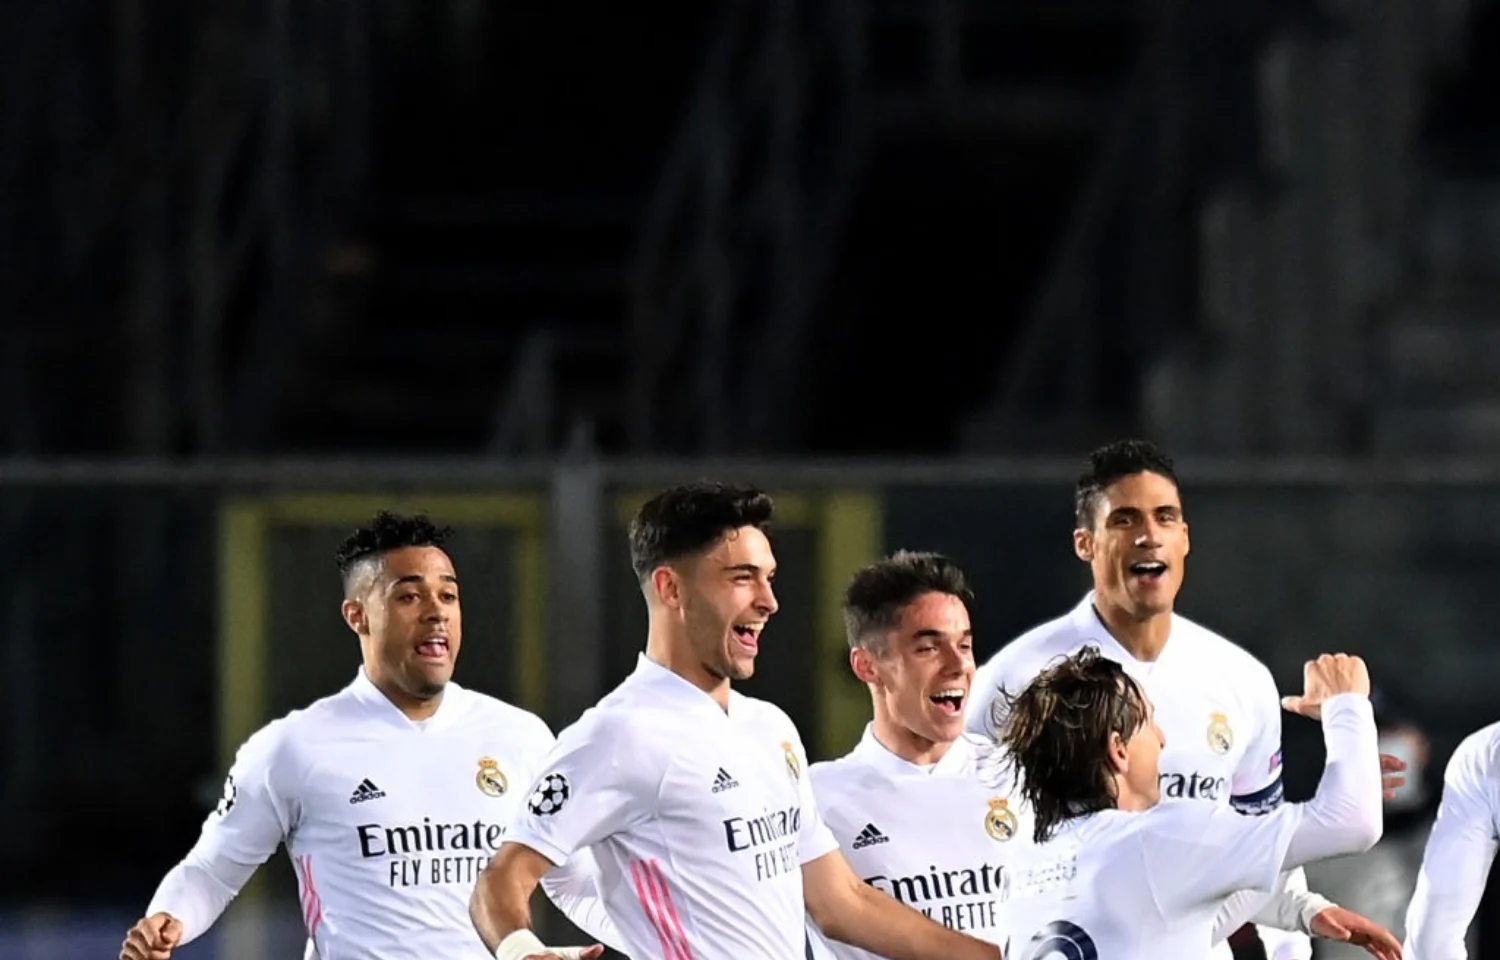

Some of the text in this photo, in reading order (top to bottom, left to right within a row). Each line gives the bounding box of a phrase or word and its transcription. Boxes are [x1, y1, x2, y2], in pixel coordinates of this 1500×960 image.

[349, 790, 387, 804] adidas
[356, 816, 507, 858] Emirate
[852, 835, 890, 850] adidas
[390, 856, 491, 887] FLY BETTE
